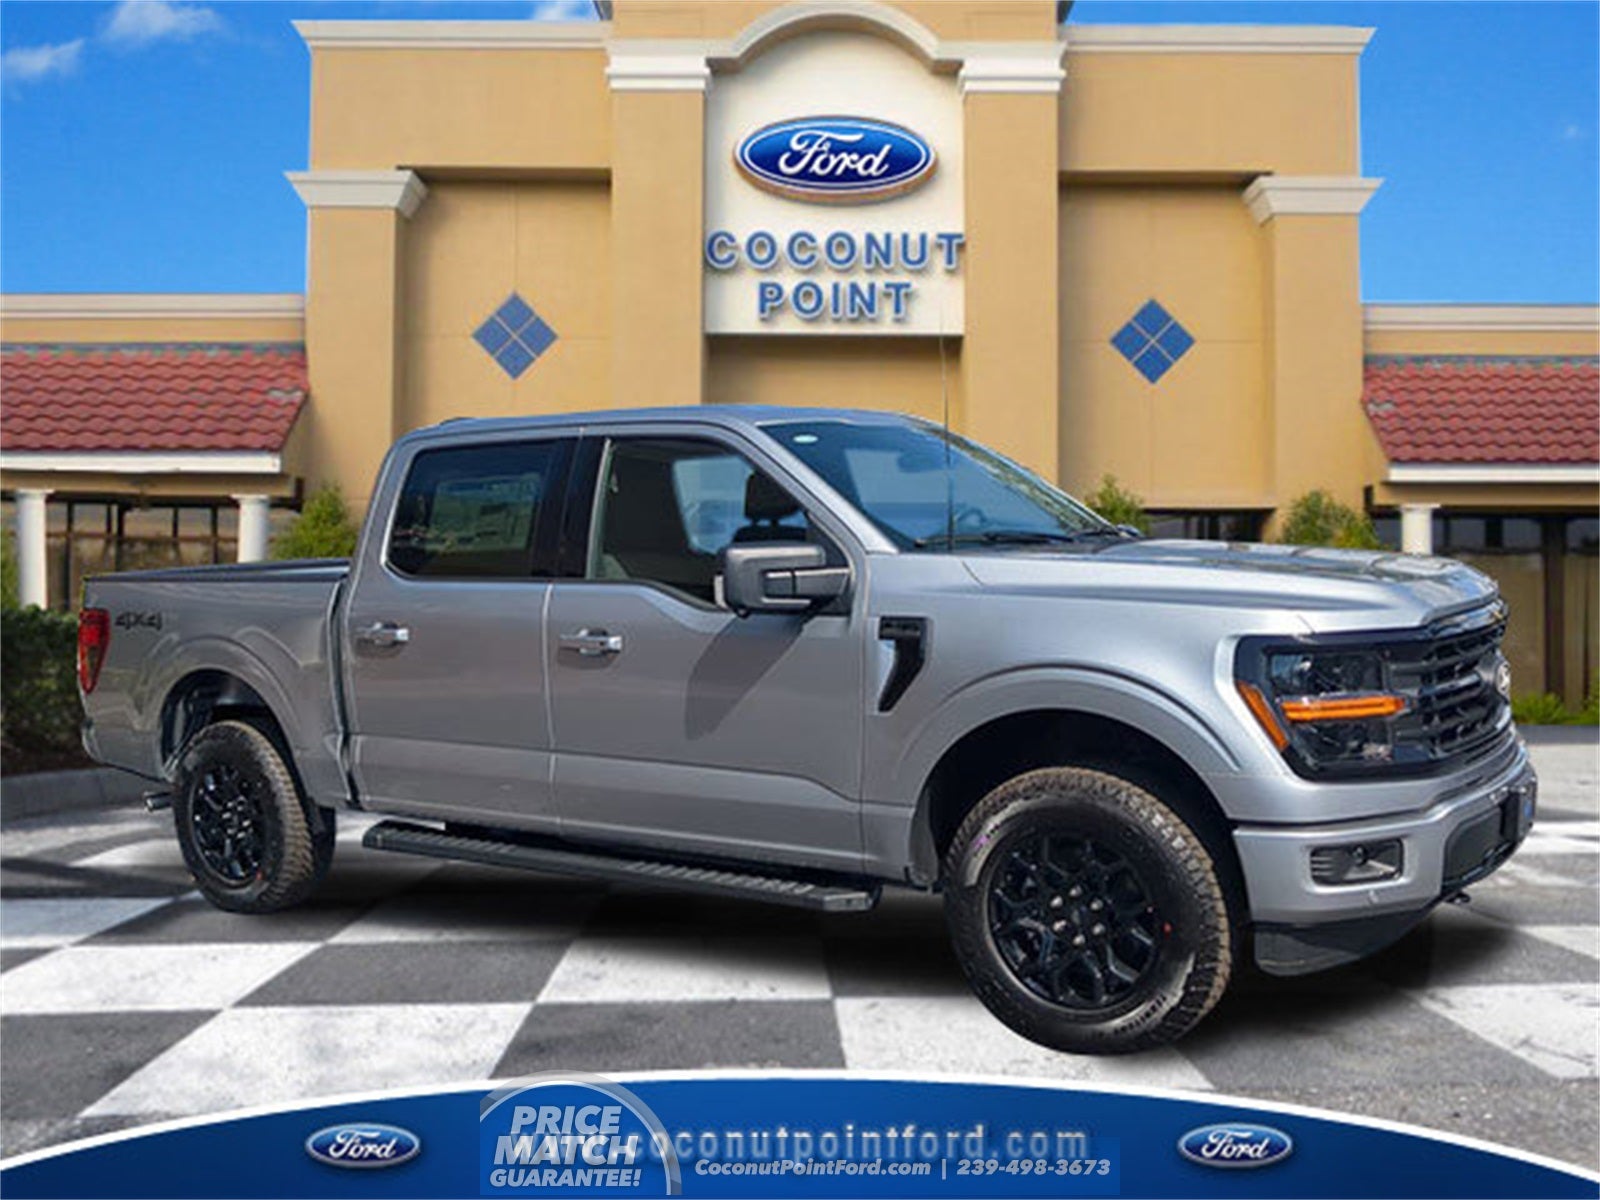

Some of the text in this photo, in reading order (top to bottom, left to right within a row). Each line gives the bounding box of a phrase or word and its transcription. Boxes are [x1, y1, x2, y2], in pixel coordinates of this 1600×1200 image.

[778, 129, 892, 176] Ford
[705, 230, 965, 269] COCONUT
[757, 281, 912, 318] POINT
